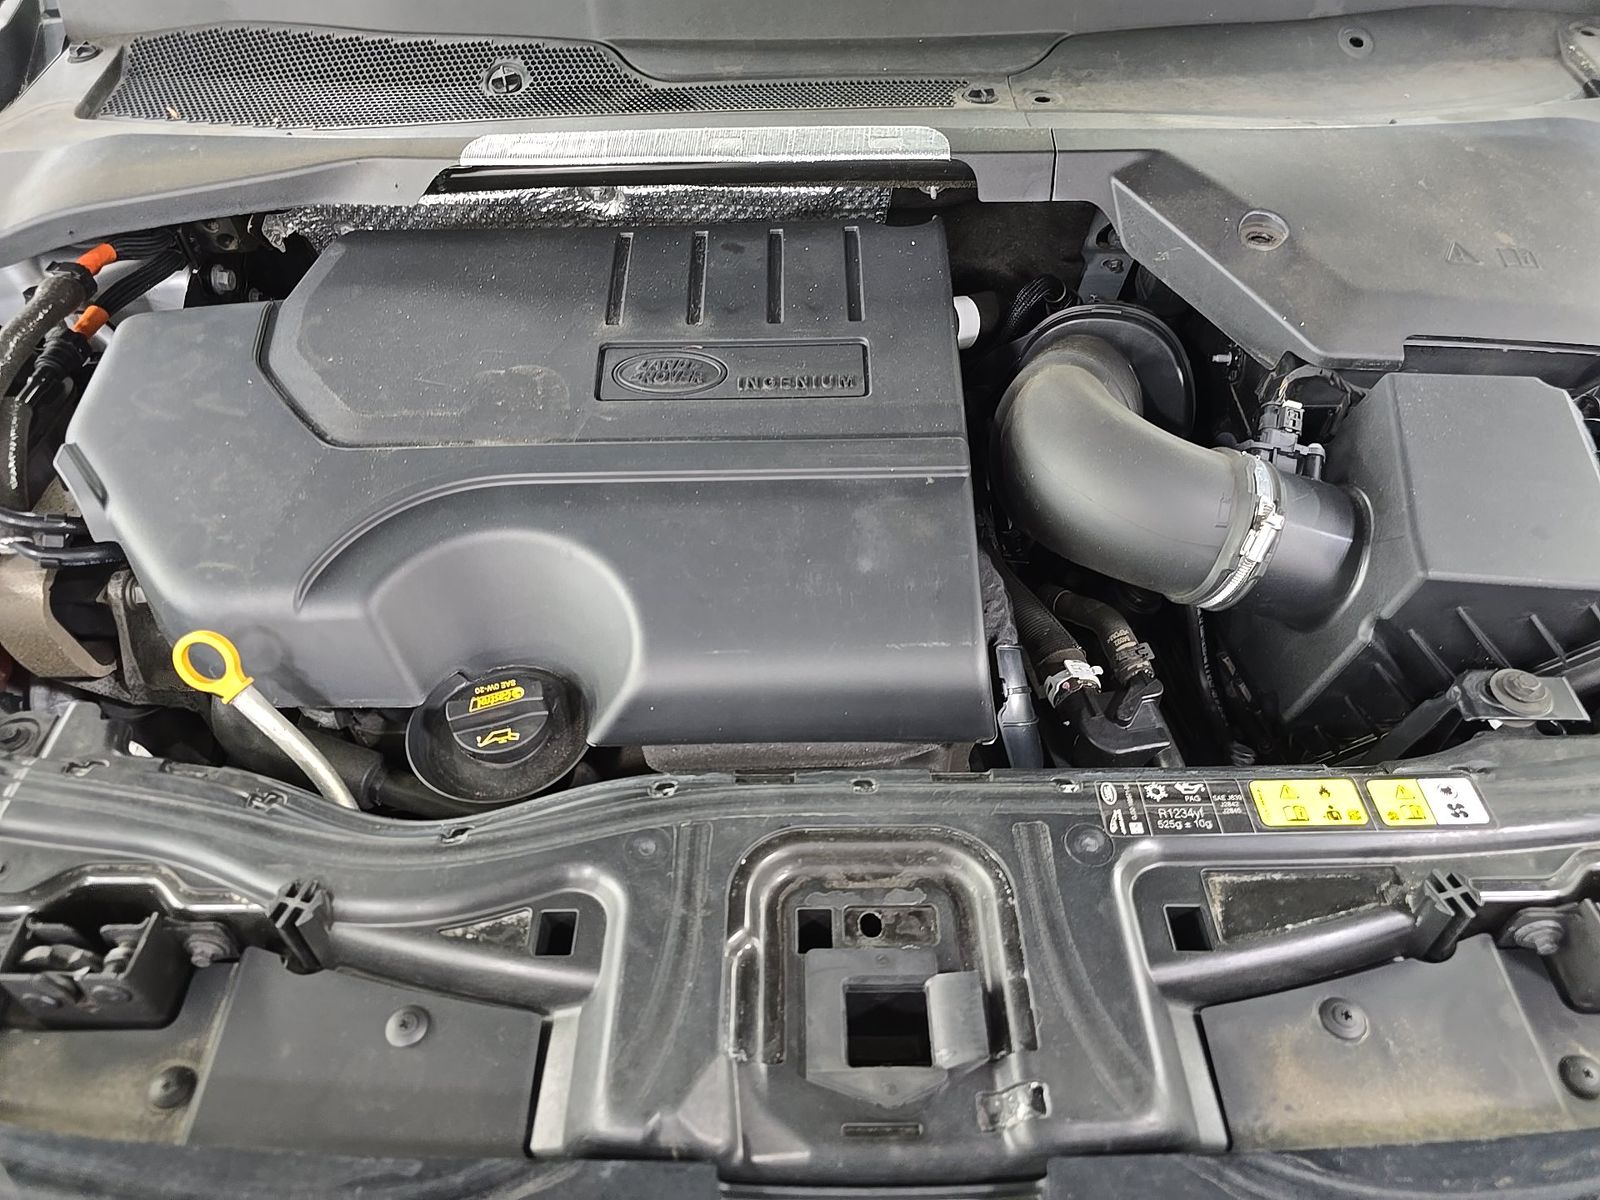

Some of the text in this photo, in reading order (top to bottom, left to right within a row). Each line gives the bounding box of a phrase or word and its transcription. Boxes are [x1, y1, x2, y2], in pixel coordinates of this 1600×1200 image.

[736, 374, 855, 391] INGENIUM
[475, 679, 517, 694] SAE 0W-20
[1158, 807, 1204, 820] R1234yf
[1157, 820, 1182, 830] 525g
[1194, 819, 1213, 830] 10g
